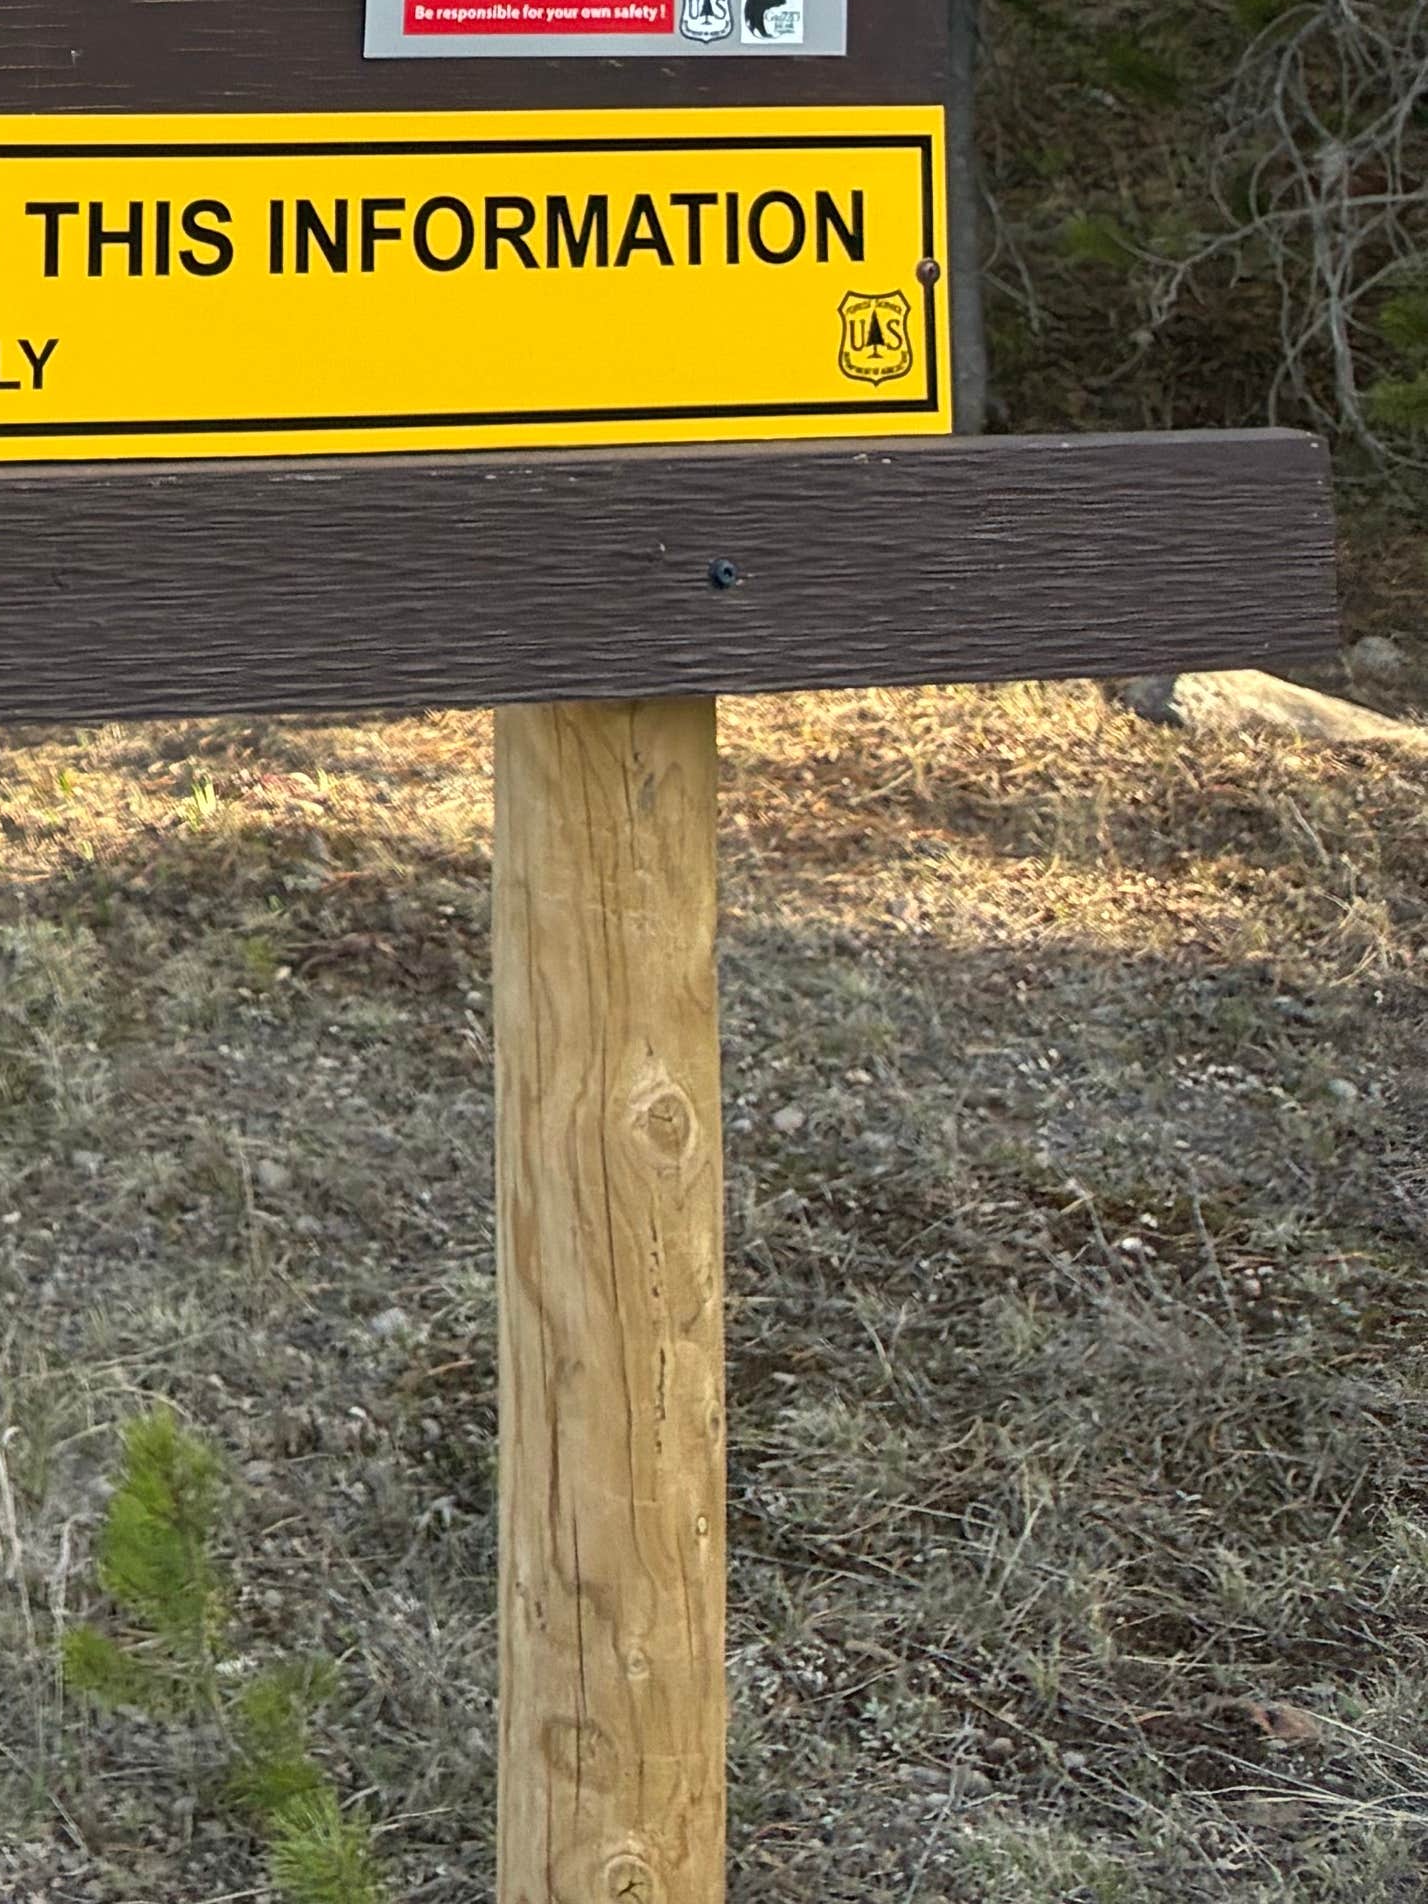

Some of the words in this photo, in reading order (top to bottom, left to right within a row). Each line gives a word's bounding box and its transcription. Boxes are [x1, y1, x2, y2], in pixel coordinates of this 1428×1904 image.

[415, 5, 434, 20] Be
[436, 4, 520, 22] responsible
[522, 4, 544, 19] for
[546, 8, 579, 22] your
[580, 7, 611, 19] own
[614, 3, 658, 22] safety
[25, 199, 233, 277] THIS
[270, 190, 864, 274] INFORMATION
